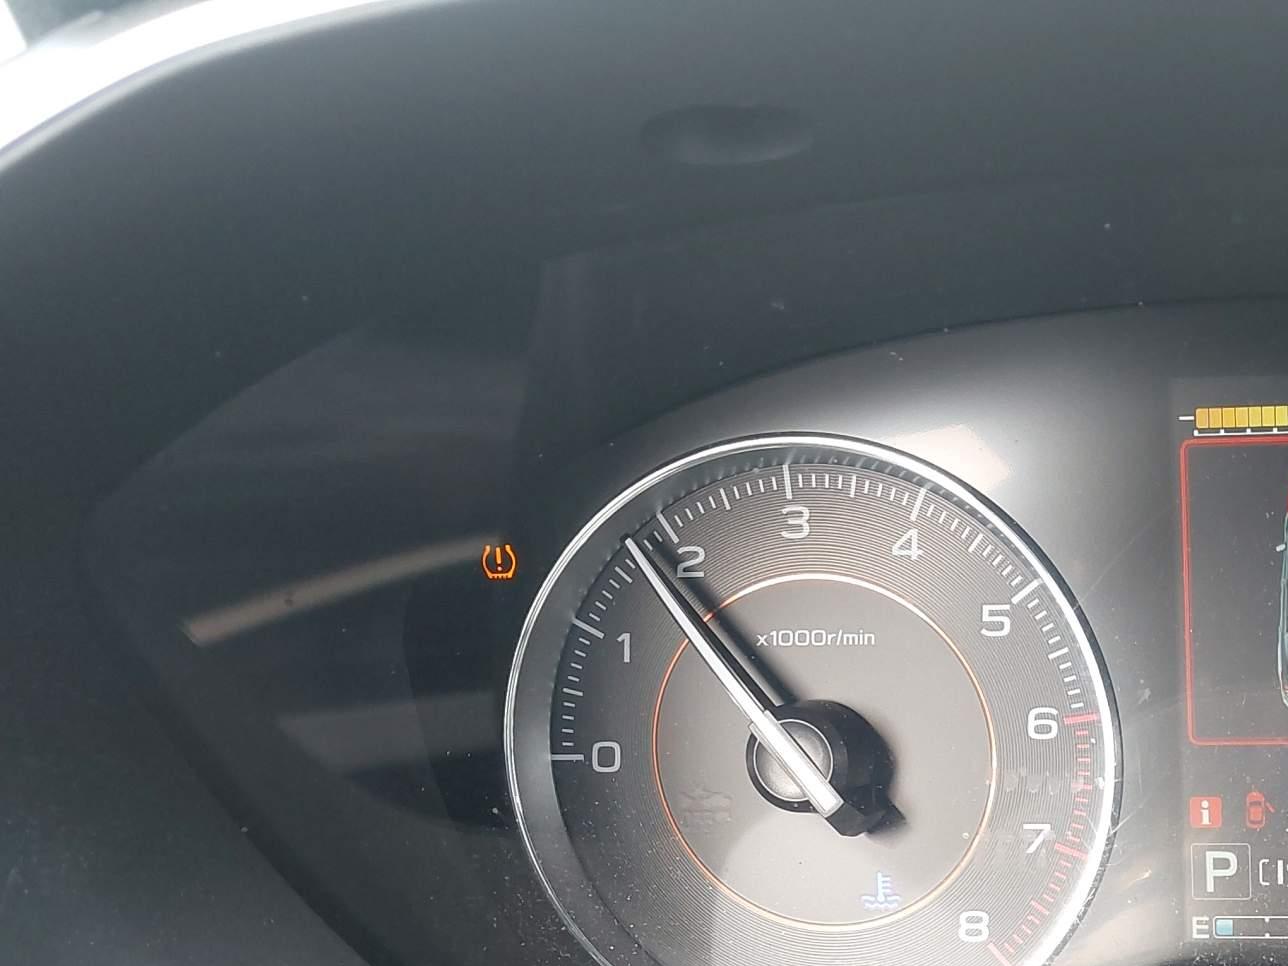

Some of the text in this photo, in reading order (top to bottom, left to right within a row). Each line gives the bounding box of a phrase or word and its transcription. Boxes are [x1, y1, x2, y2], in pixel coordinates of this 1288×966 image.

[781, 507, 810, 539] 3
[892, 529, 923, 560] 4
[677, 545, 706, 578] 2
[981, 604, 1011, 638] 5
[616, 632, 632, 663] 1
[756, 628, 876, 648] x1000r/min
[1027, 707, 1059, 739] 6
[591, 741, 621, 773] 0
[1023, 823, 1052, 853] 7
[1205, 851, 1237, 892] P
[958, 911, 990, 943] 8
[1192, 916, 1209, 939] E
